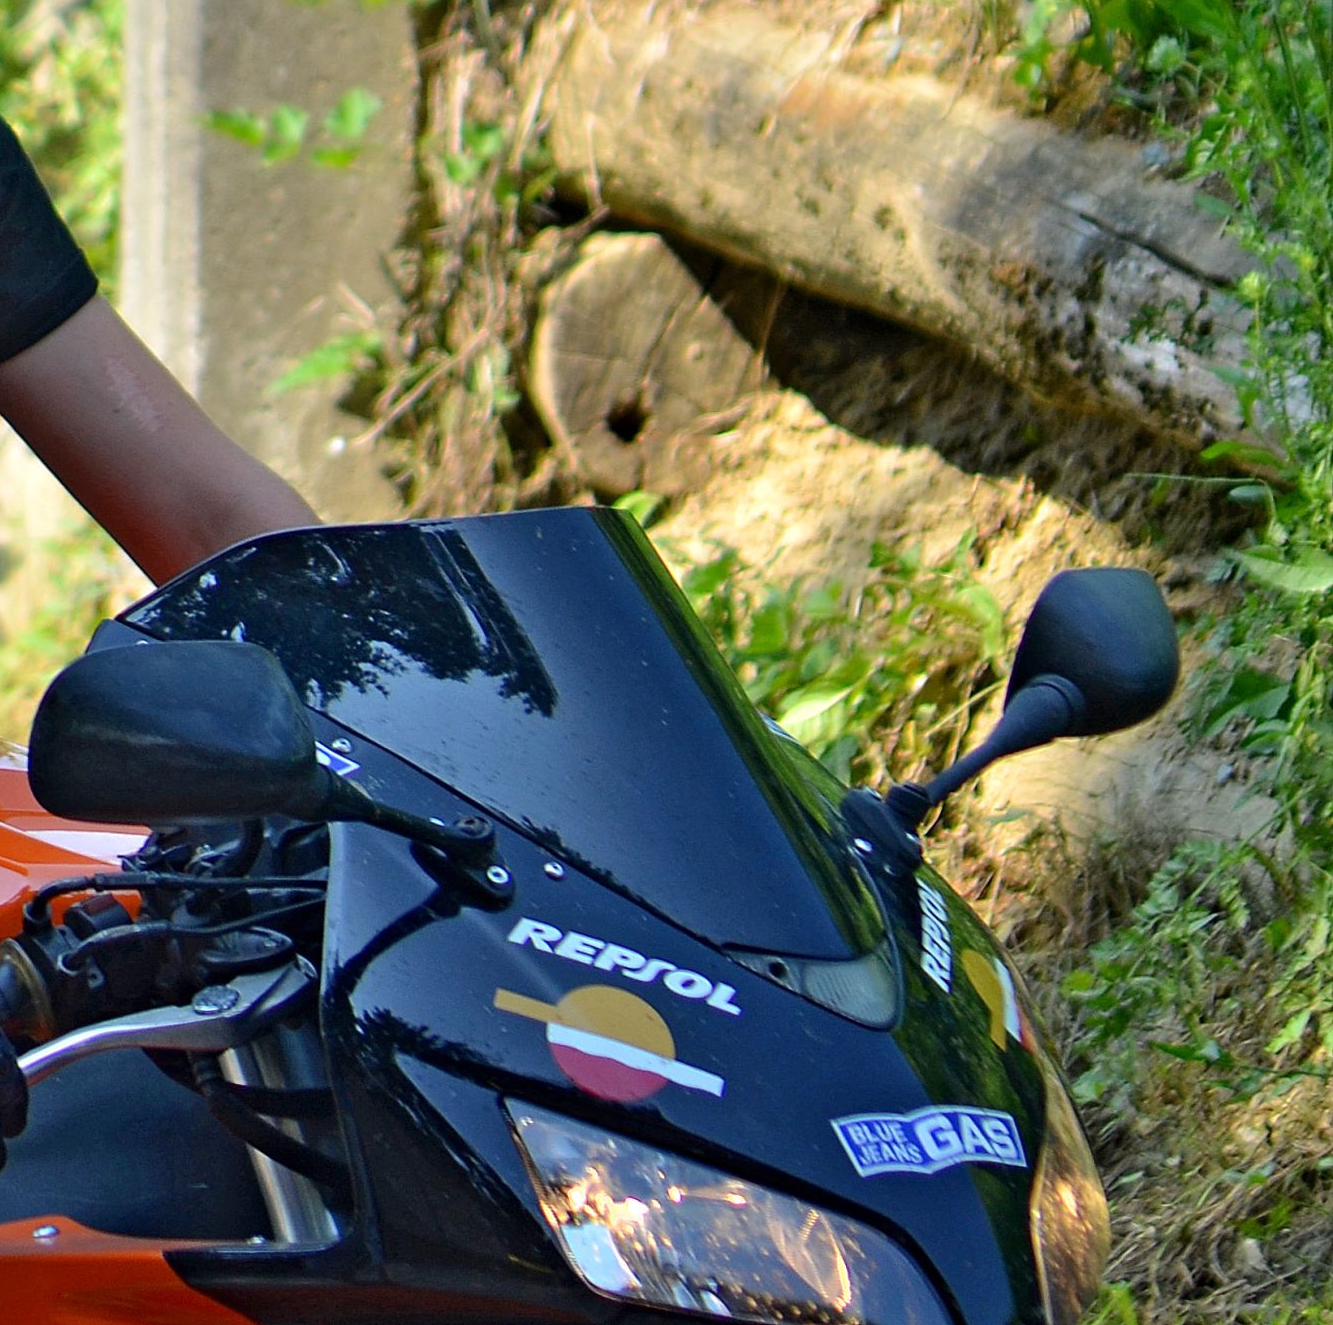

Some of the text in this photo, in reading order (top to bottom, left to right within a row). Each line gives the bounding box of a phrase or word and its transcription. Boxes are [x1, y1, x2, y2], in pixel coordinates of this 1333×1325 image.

[916, 876, 952, 994] REPSOL
[507, 917, 743, 1016] REPSOL
[848, 1121, 908, 1145] BLUE
[859, 1140, 924, 1165] JEANS
[915, 1114, 1017, 1162] GAS
